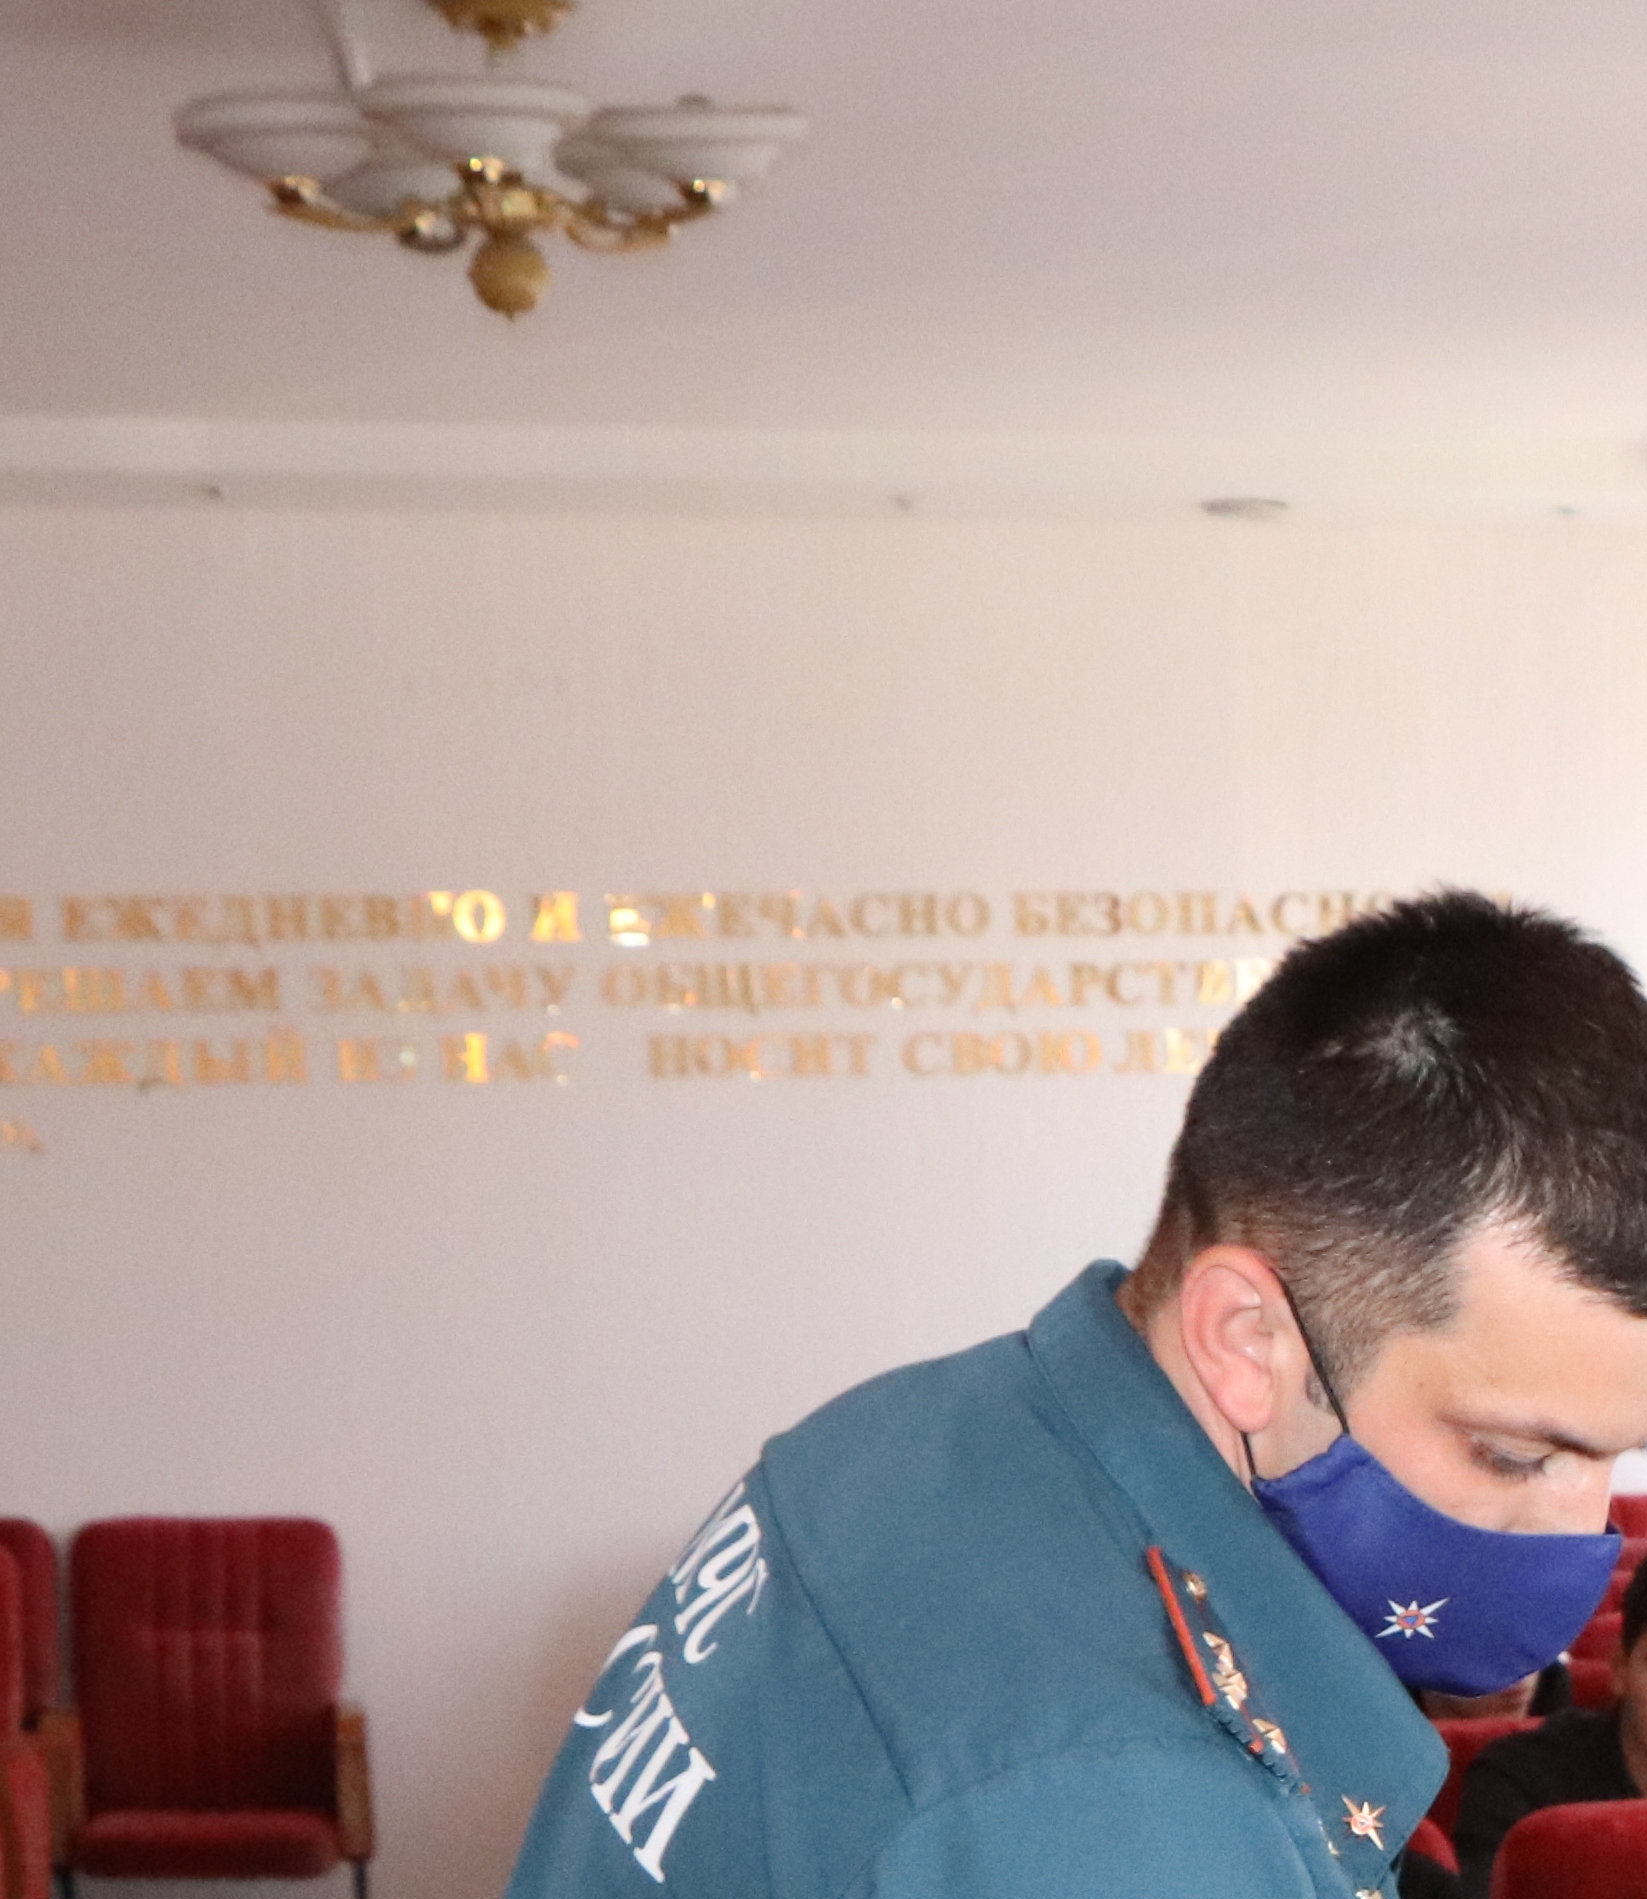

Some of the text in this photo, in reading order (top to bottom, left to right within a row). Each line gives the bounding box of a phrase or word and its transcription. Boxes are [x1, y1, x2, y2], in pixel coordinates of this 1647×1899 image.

[60, 890, 506, 948] ЕЖЕДНЕВНО
[0, 966, 279, 1012] ЕШАЕМ
[314, 963, 577, 1014] ЗАДАЧУ
[901, 1031, 1101, 1077] СВОЮ
[1112, 1026, 1220, 1076] ЛЕ
